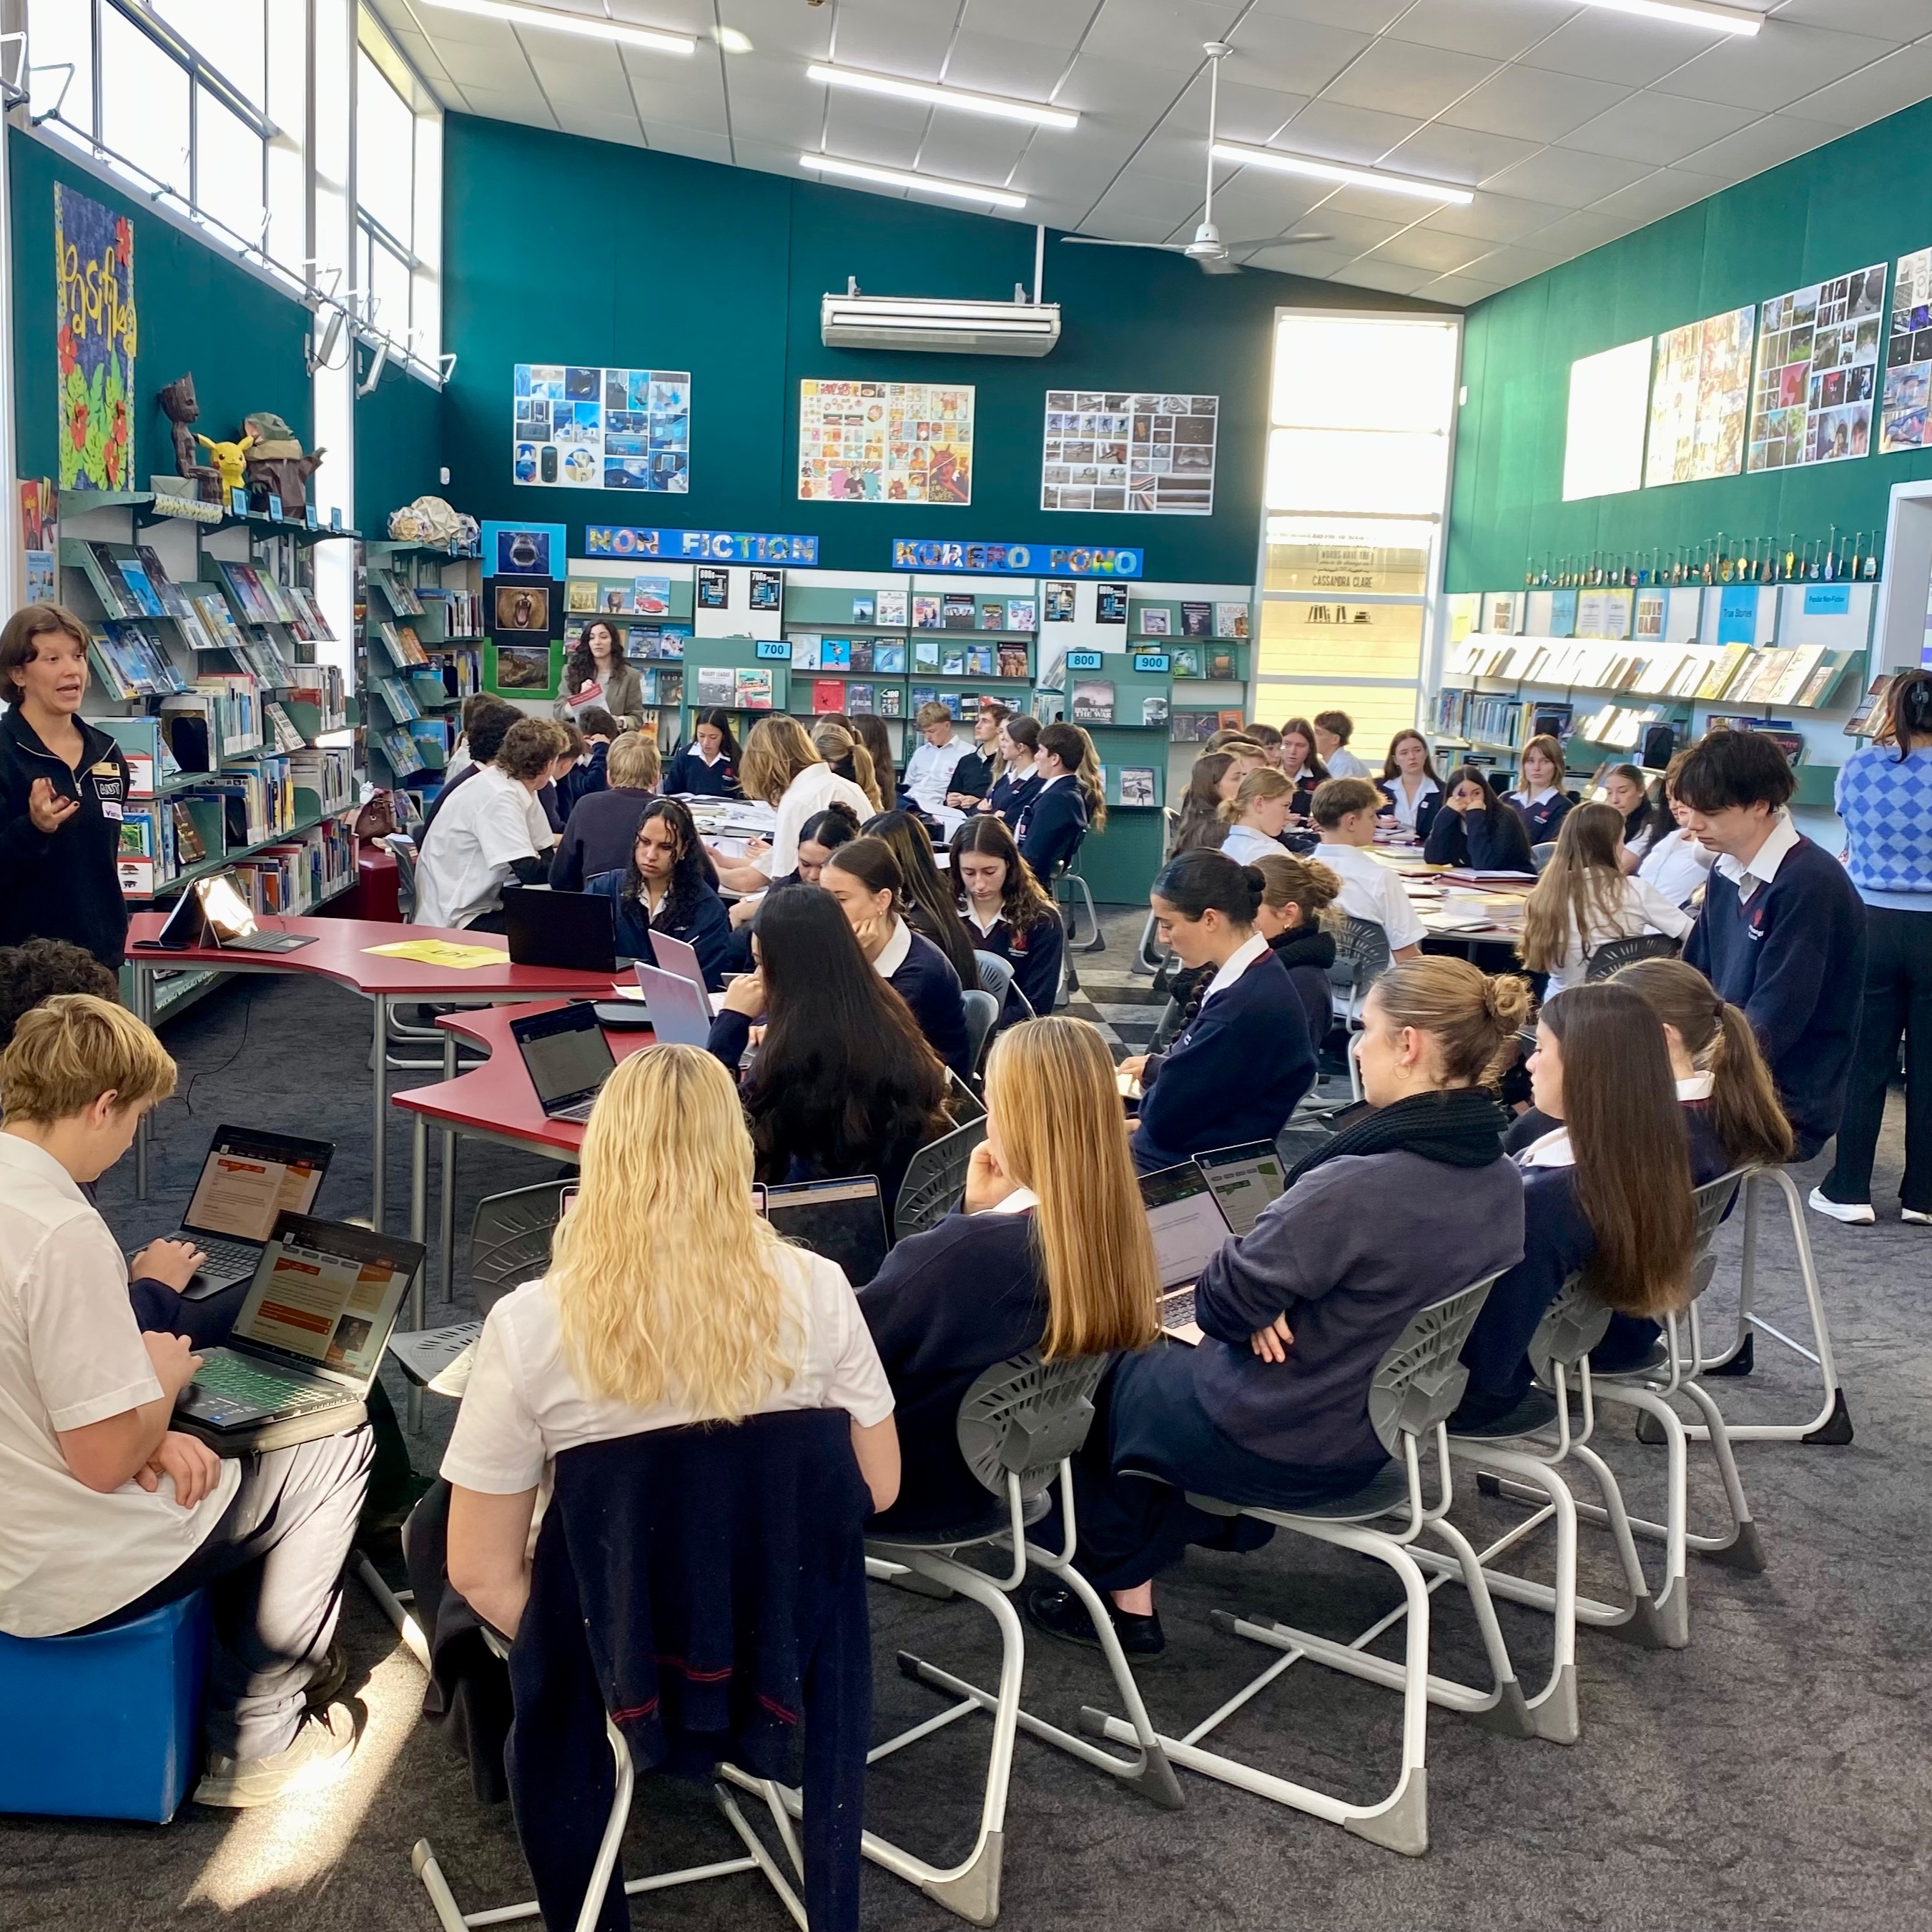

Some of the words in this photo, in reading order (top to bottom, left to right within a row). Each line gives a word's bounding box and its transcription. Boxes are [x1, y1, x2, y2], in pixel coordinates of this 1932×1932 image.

[589, 528, 659, 555] NON
[683, 533, 815, 562] FICTION
[896, 541, 1030, 569] KORERO
[1050, 548, 1138, 575] PONO
[1312, 575, 1351, 587] CASSANDRA
[1352, 576, 1373, 588] CLARE
[1723, 608, 1734, 618] True
[1735, 608, 1753, 618] Stories
[764, 644, 784, 655] 700
[1074, 655, 1095, 665] 800
[1142, 657, 1163, 668] 900
[99, 782, 120, 795] AUT
